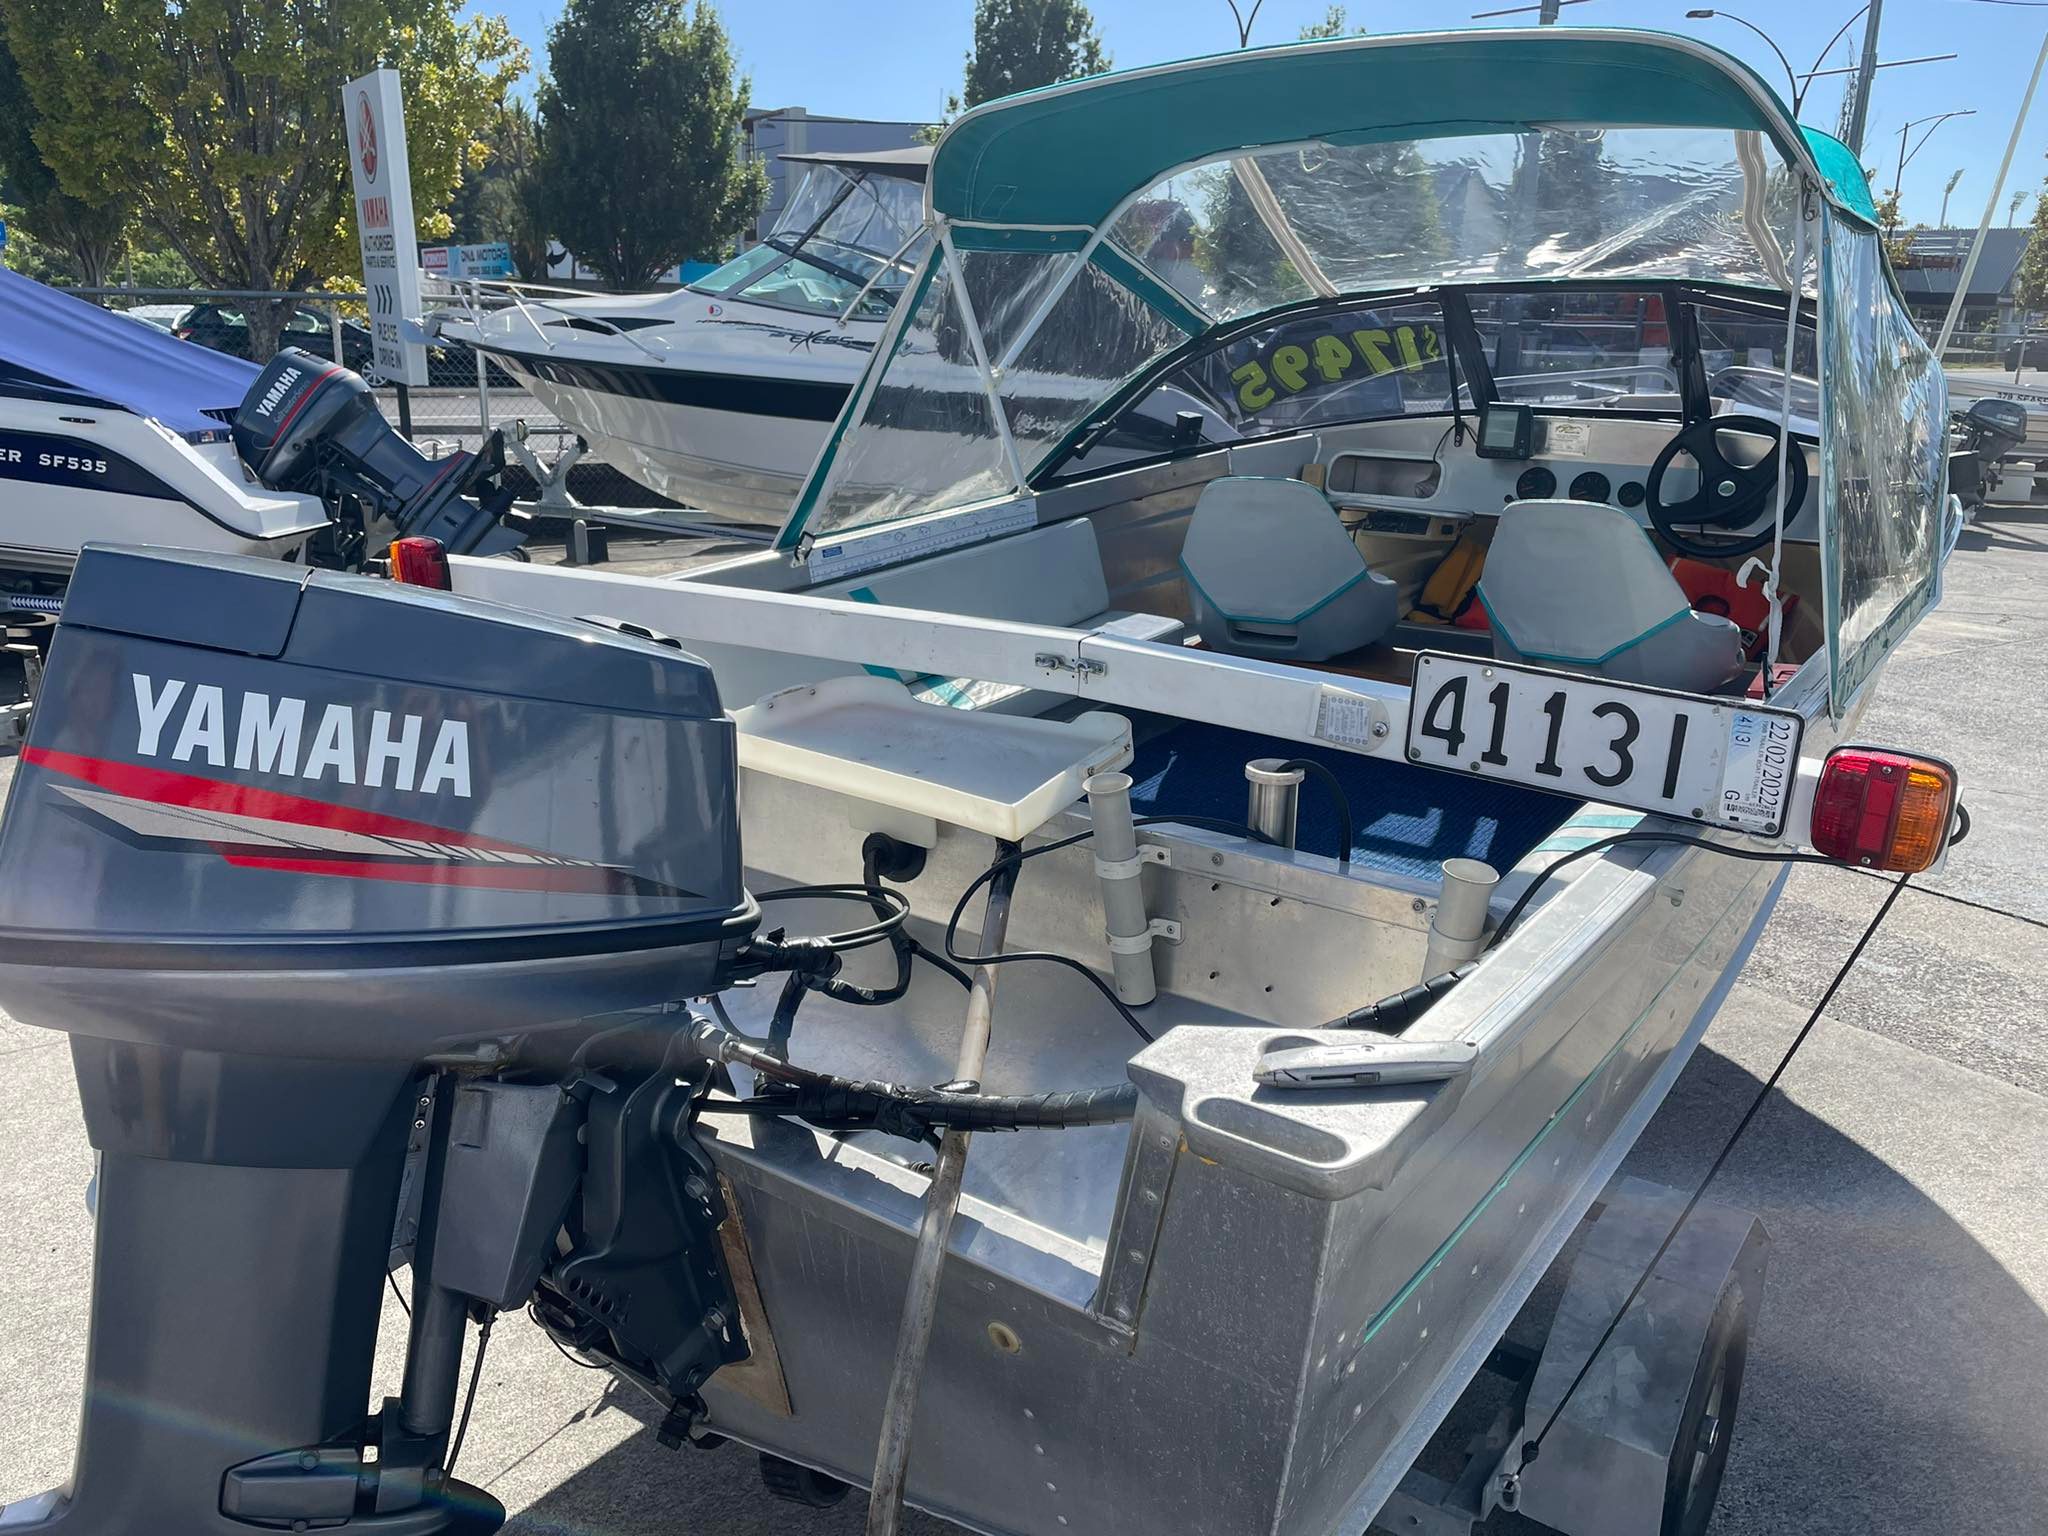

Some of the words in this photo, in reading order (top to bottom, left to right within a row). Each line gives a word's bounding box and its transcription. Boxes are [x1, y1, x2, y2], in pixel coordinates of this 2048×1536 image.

[362, 196, 390, 229] YAMAHA
[477, 247, 507, 261] MOTORS
[377, 322, 398, 344] PLEASE
[256, 367, 302, 417] YAMAHA
[38, 453, 107, 473] SF535
[132, 673, 472, 798] YAMAHA
[1758, 721, 1791, 806] 22/02/2022
[1724, 789, 1740, 801] G
